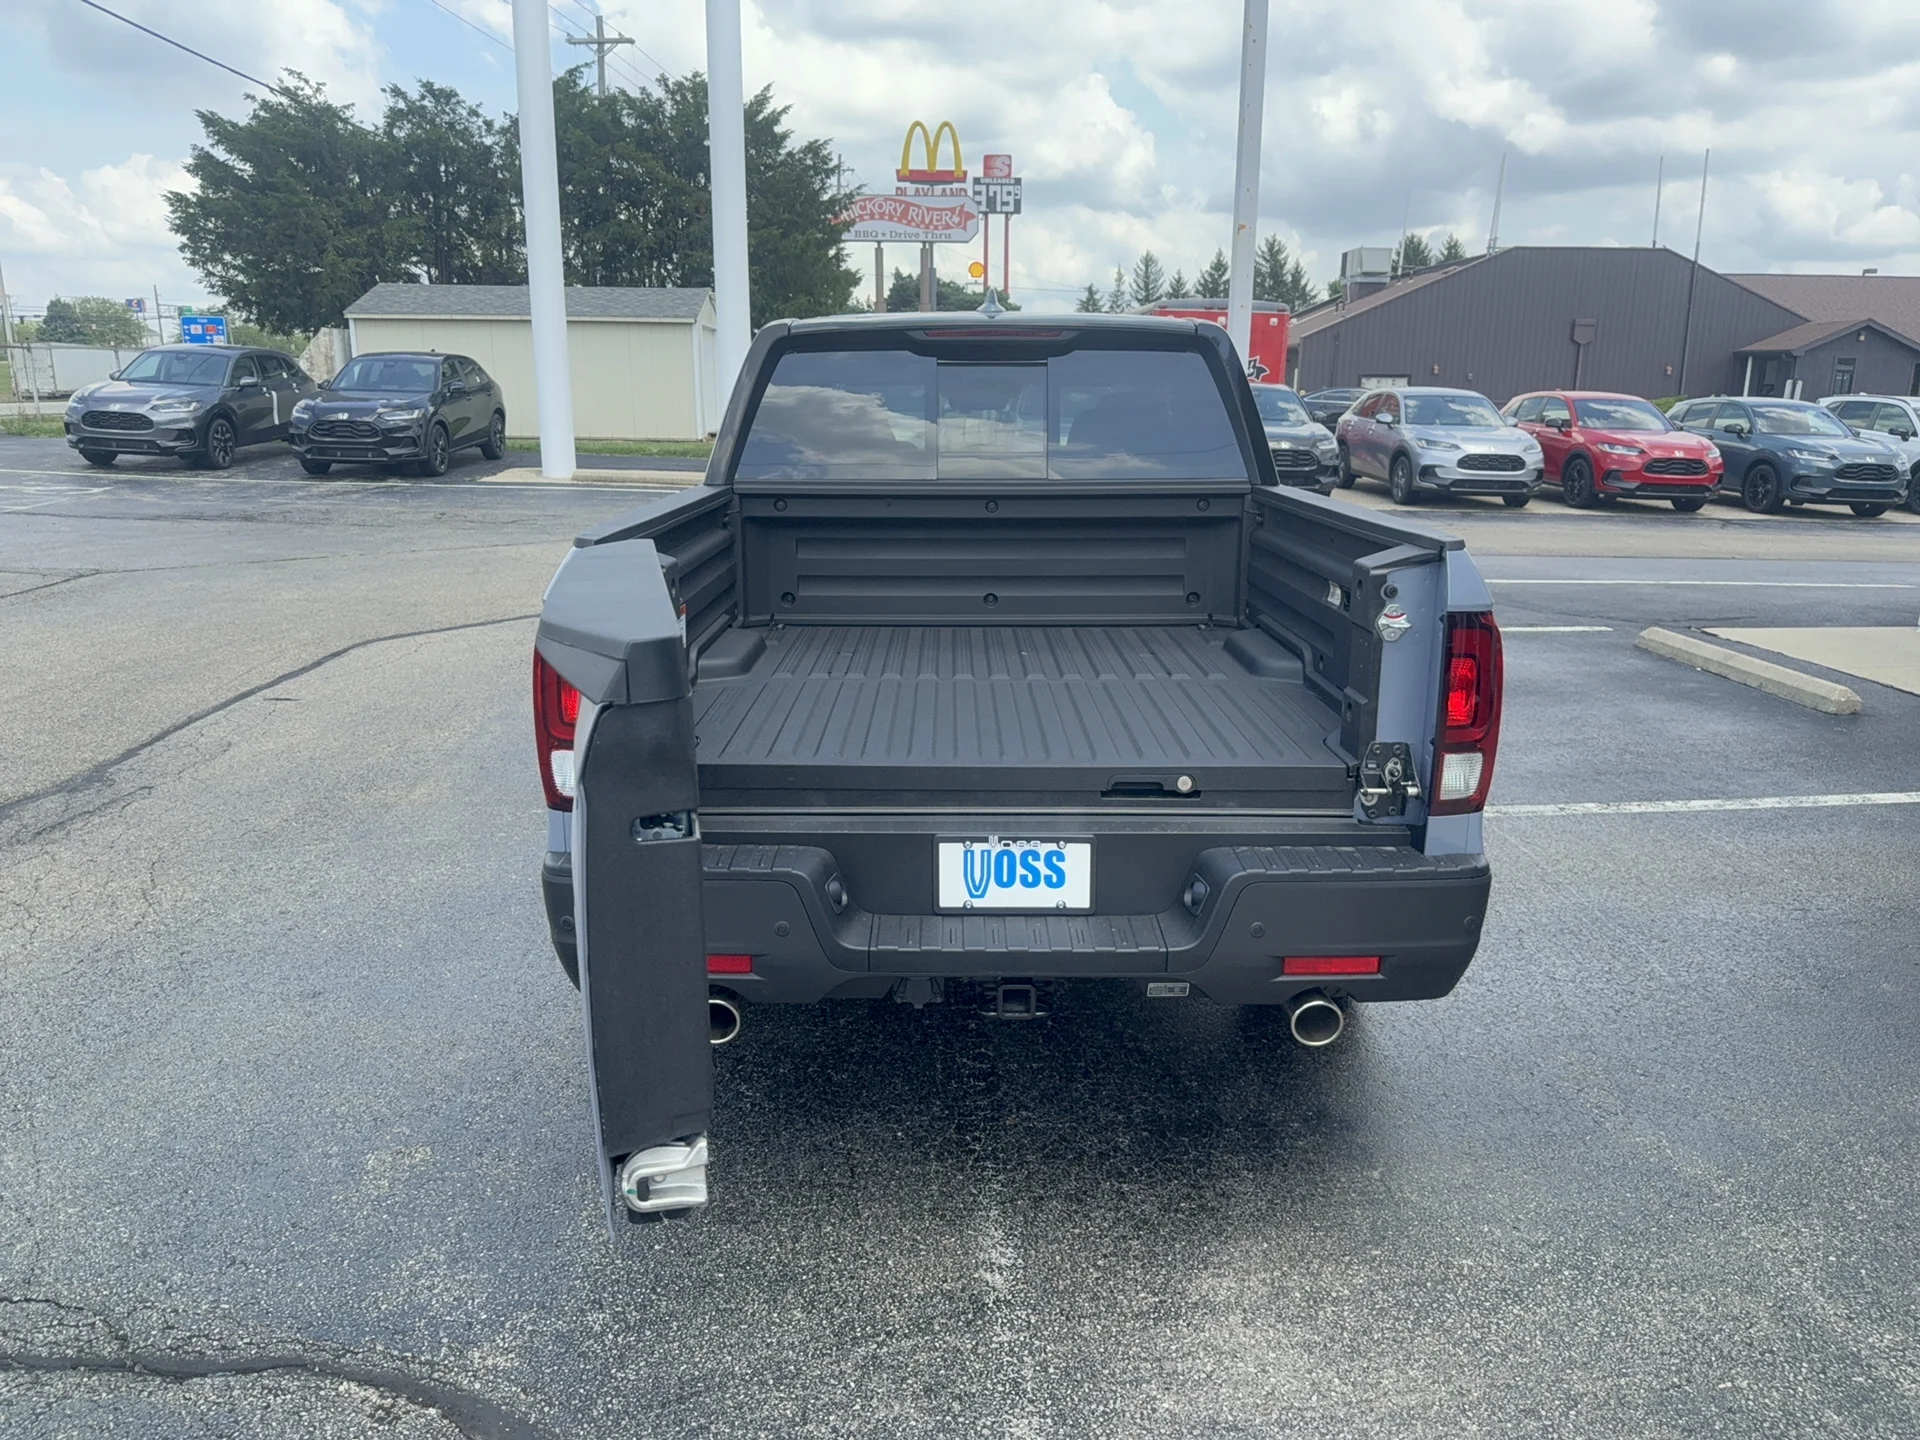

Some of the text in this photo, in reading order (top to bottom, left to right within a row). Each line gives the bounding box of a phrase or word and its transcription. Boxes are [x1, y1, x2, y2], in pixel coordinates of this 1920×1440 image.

[896, 186, 968, 197] PLAYLAND
[841, 197, 905, 221] HICKORY
[854, 230, 952, 239] BBQ Drive Thru
[988, 835, 1041, 848] VOSS
[963, 849, 1066, 899] VOSS
